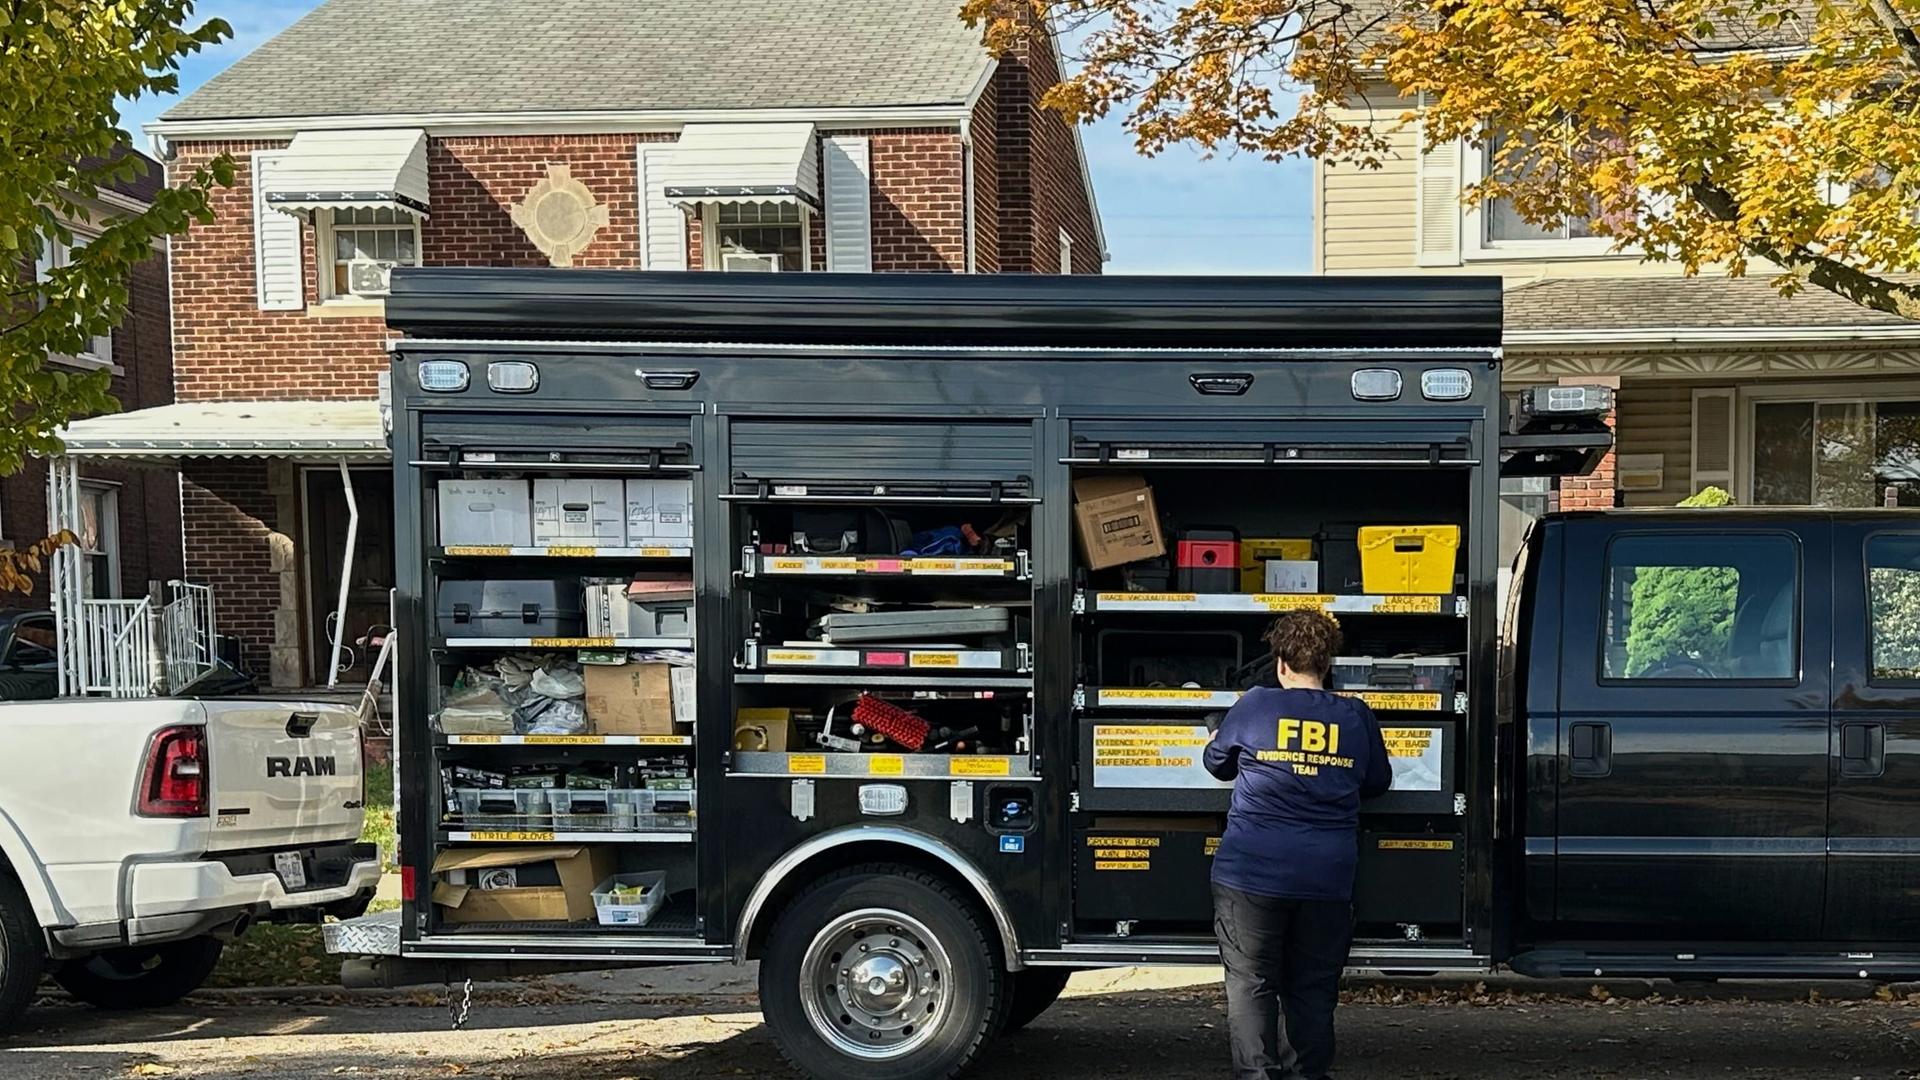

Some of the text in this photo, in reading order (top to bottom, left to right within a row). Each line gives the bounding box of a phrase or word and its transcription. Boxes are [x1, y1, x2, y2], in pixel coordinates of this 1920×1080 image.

[1384, 596, 1413, 604] LARGE
[531, 639, 615, 647] PHOTO SUPPLIES
[1419, 701, 1437, 709] BIN
[1278, 718, 1339, 754] FBI
[1405, 740, 1430, 748] BAGS
[1096, 758, 1192, 766] REFERENCE BINDER
[1256, 750, 1354, 768] EVIDENCE RESPONSE
[266, 756, 335, 777] RAM
[1292, 764, 1318, 775] TEAM
[470, 832, 555, 840] NITRILE GLOVES
